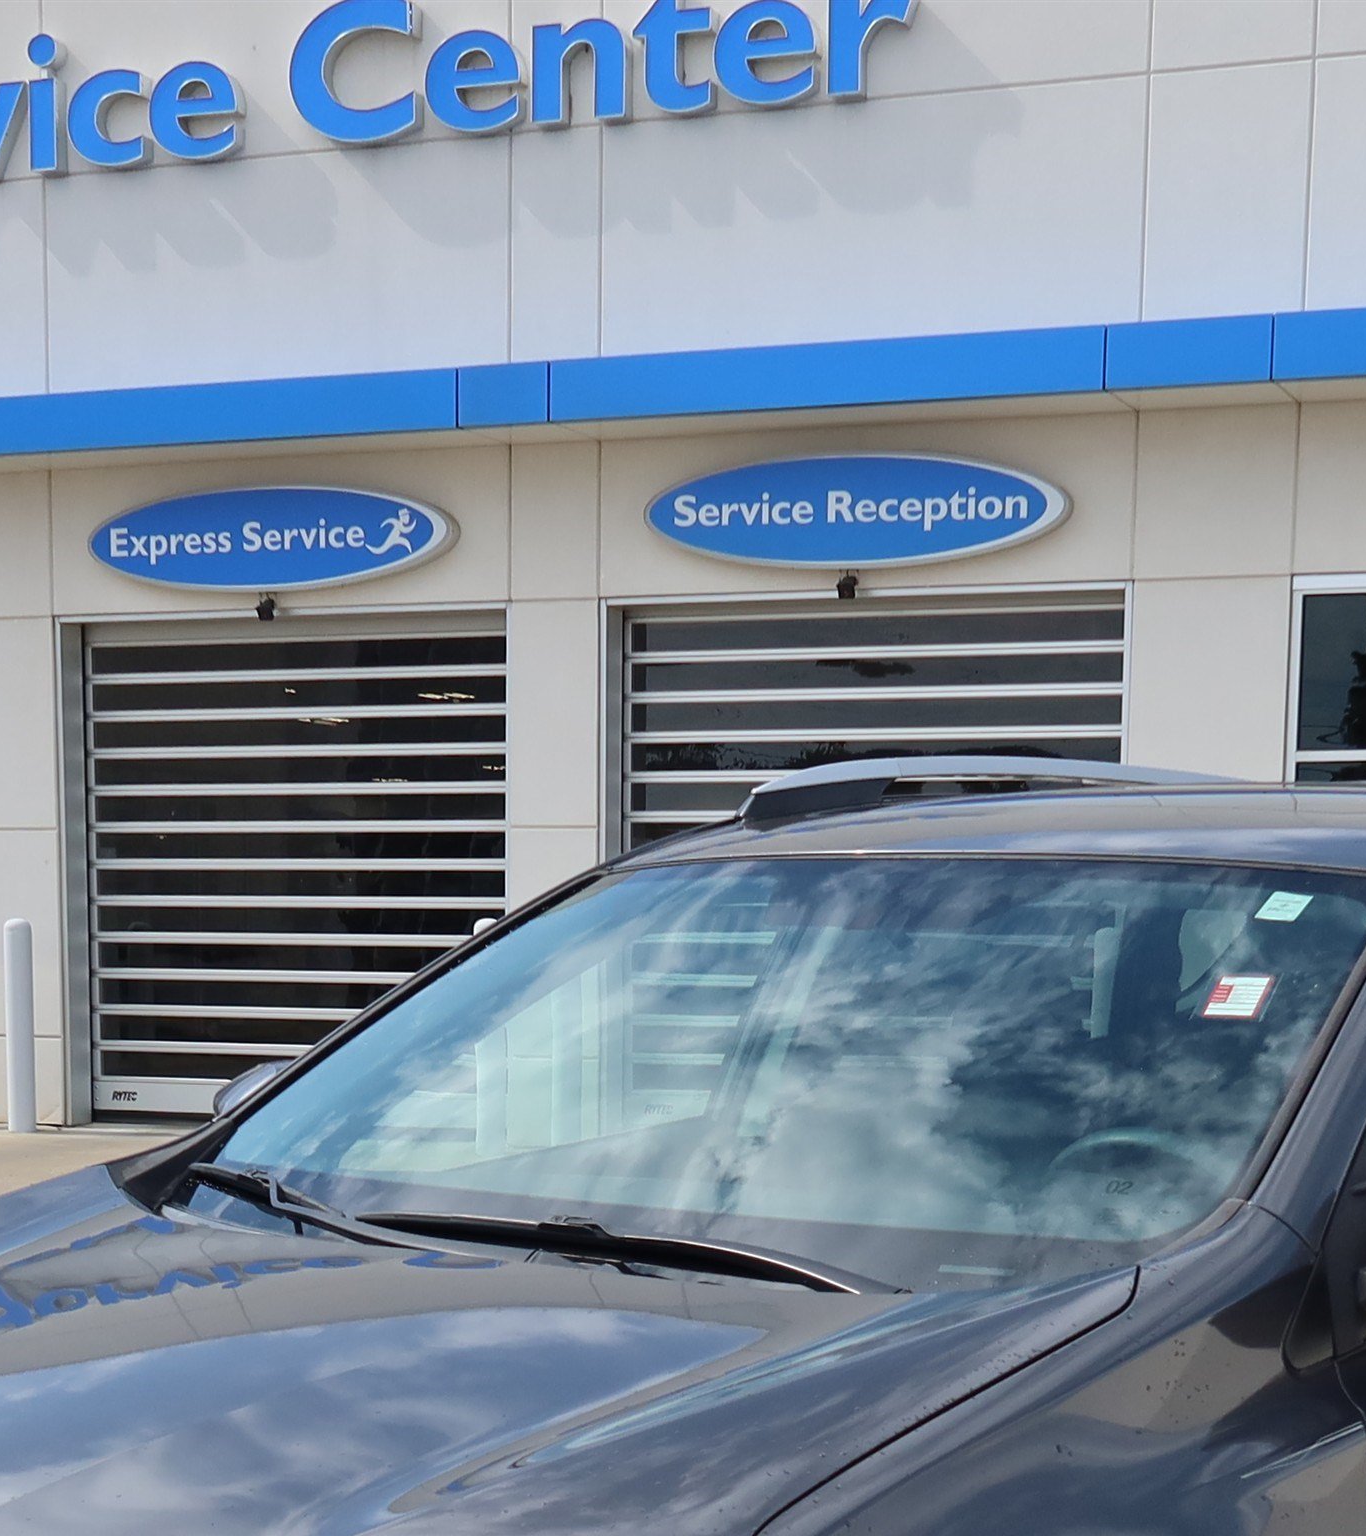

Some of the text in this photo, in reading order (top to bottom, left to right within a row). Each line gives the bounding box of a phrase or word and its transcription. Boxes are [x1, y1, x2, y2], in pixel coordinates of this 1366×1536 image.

[289, 0, 919, 142] Center
[673, 486, 1029, 532] Service Reception
[109, 518, 366, 565] Express Service
